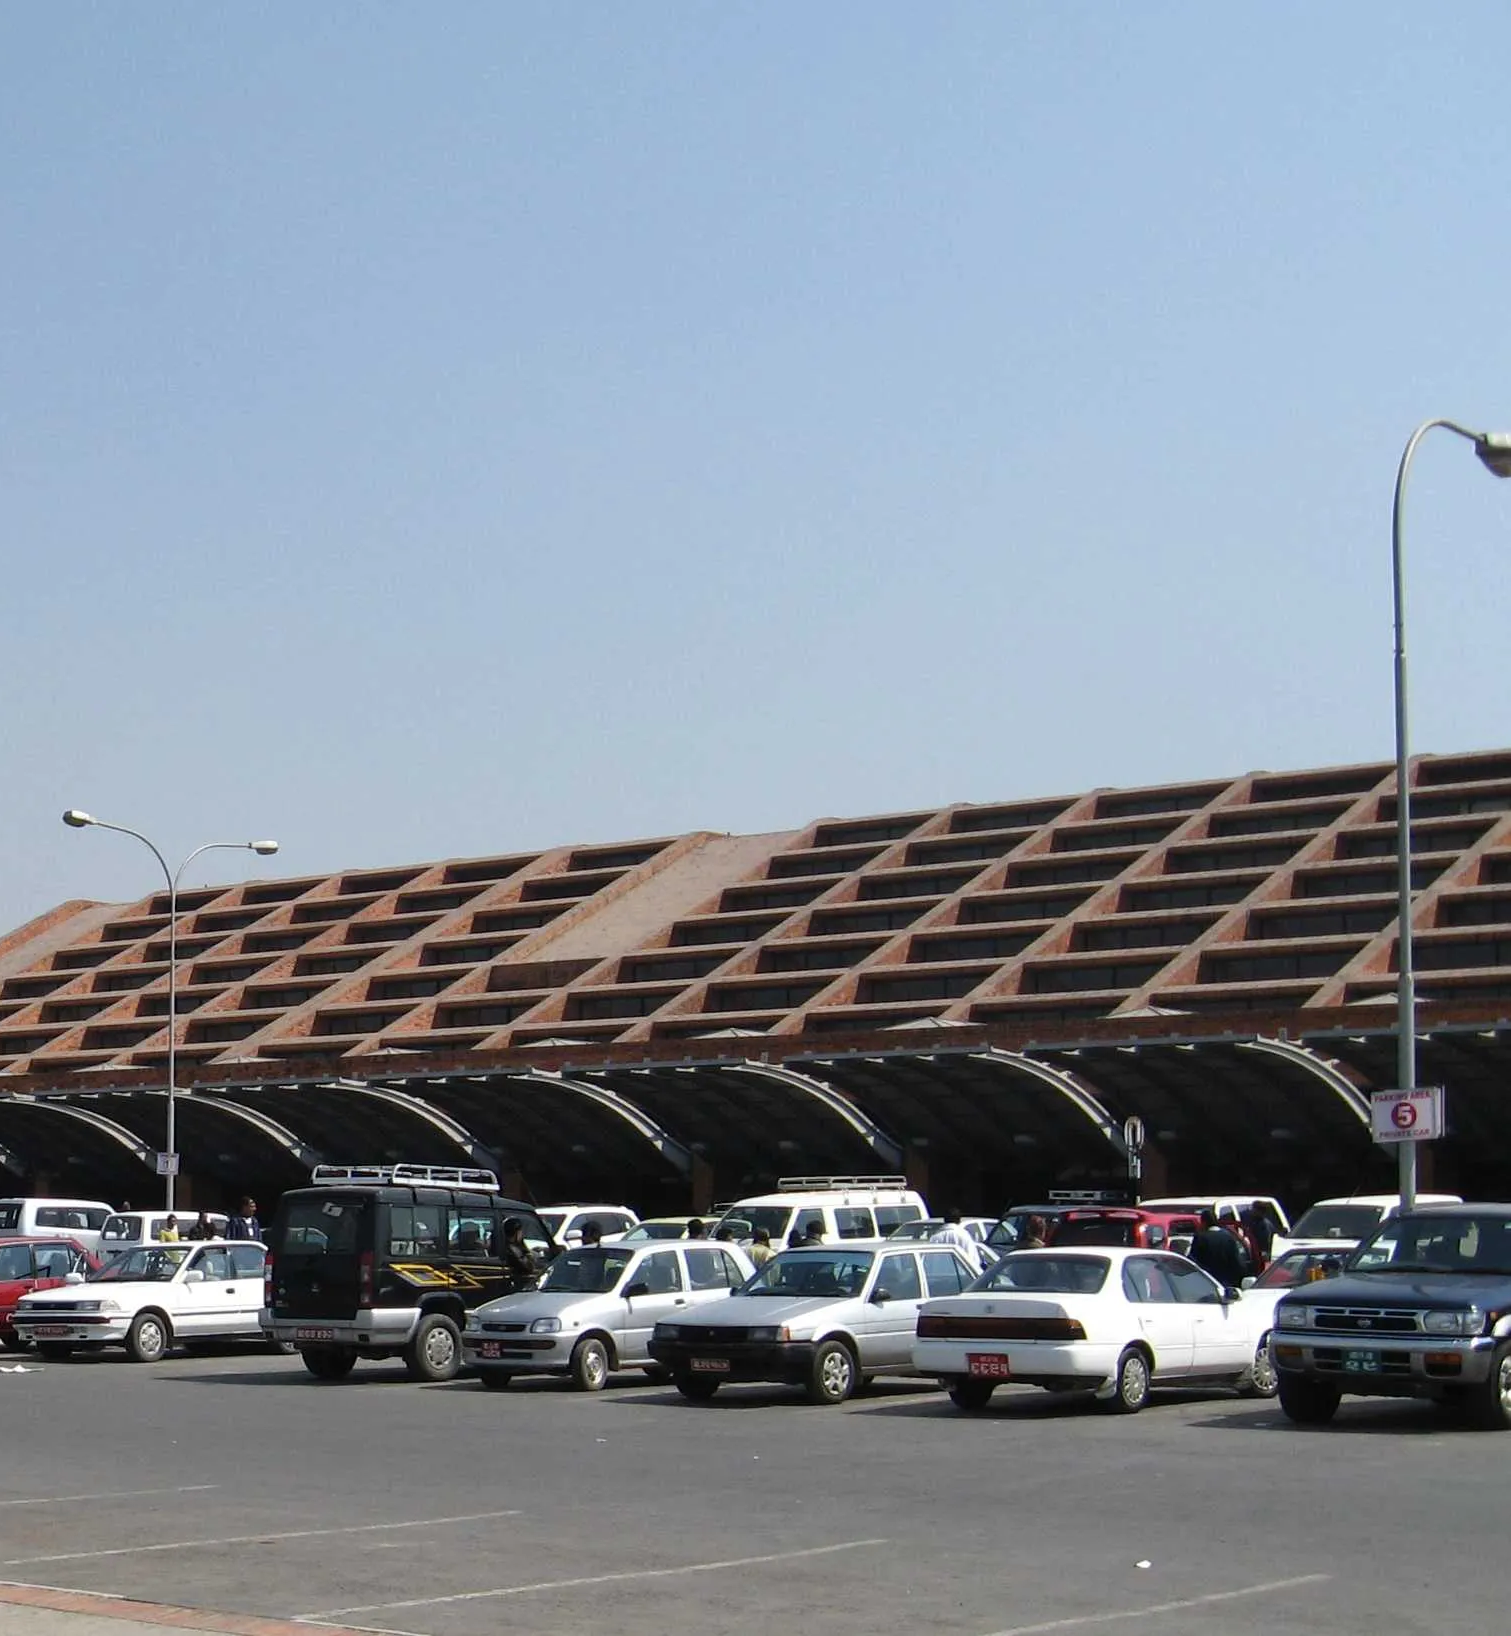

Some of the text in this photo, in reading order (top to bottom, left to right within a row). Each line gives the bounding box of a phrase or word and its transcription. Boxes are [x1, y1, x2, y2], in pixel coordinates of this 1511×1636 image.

[1374, 1090, 1430, 1102] PARKING AREA
[1397, 1105, 1411, 1125] 5
[1379, 1128, 1430, 1138] PRIVATE CAR
